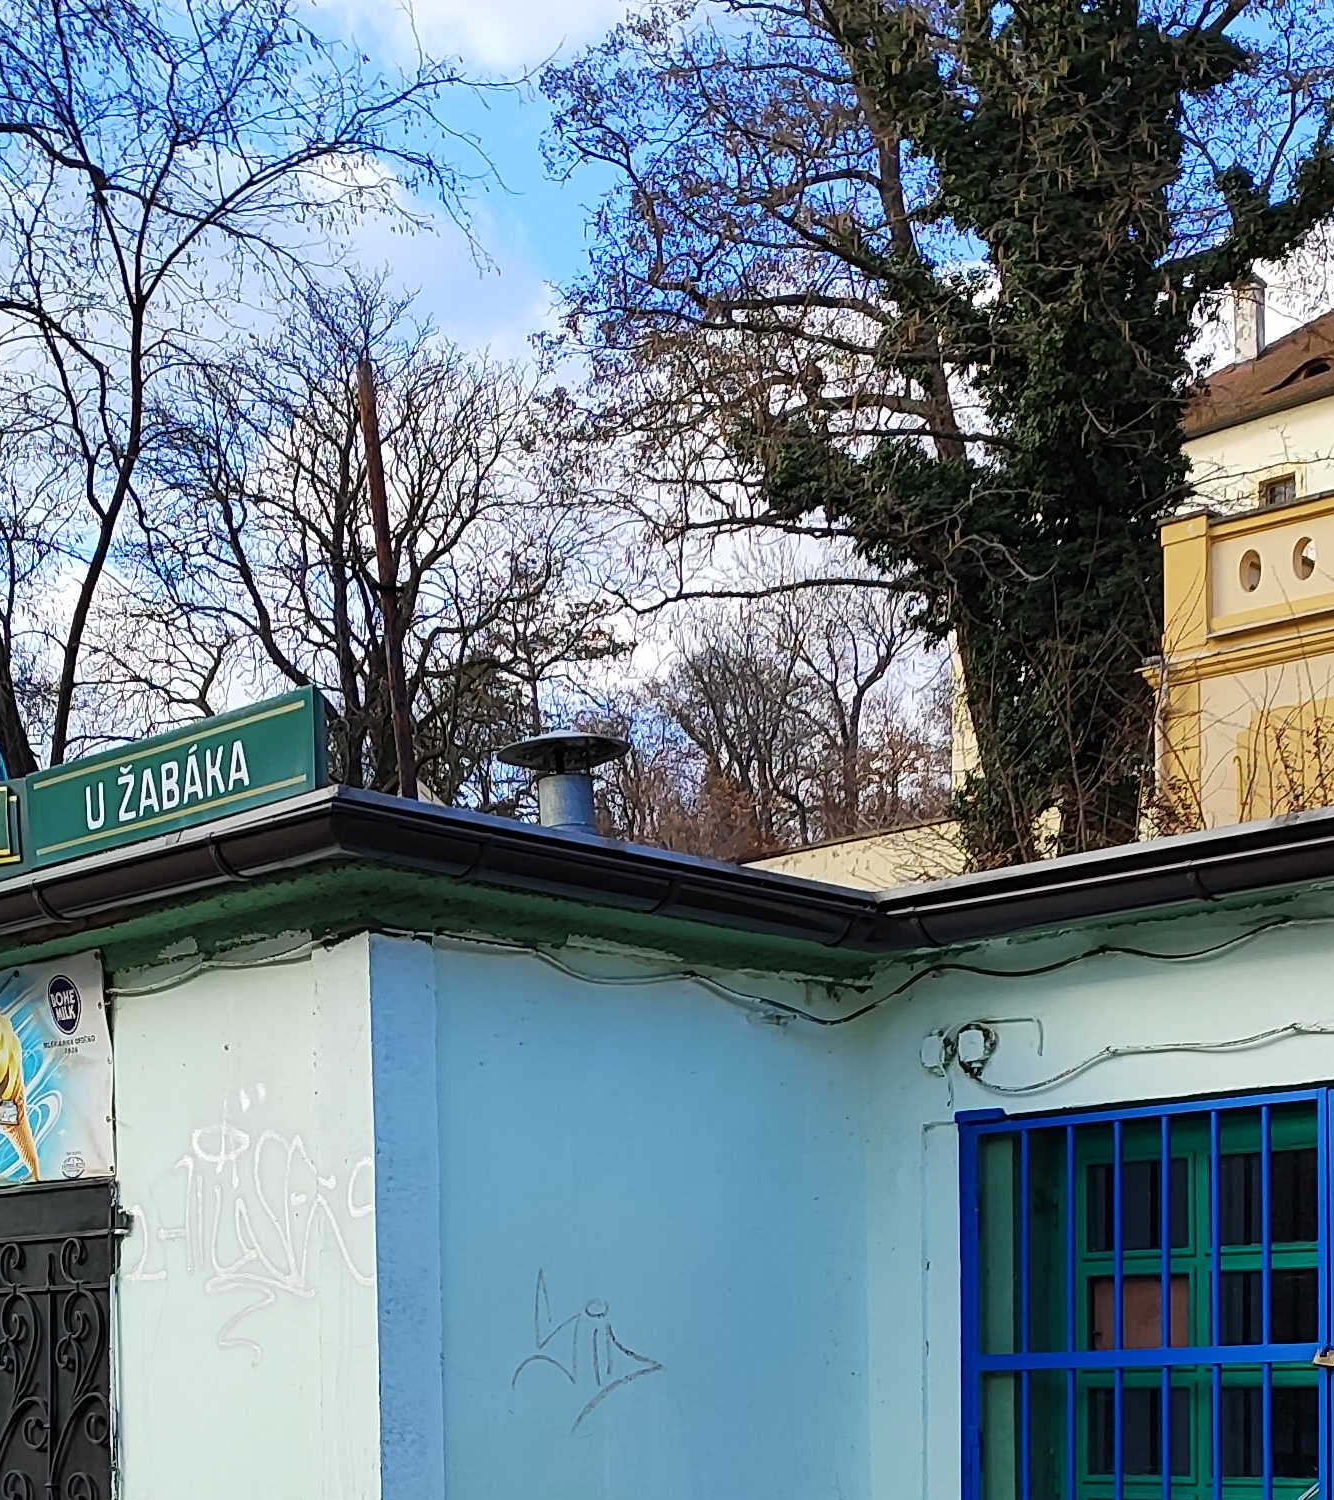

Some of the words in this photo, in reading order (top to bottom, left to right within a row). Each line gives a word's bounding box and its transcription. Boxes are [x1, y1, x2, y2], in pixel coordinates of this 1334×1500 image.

[84, 780, 106, 832] U
[117, 739, 250, 822] ŽABÁKA
[55, 1006, 76, 1022] MILK
